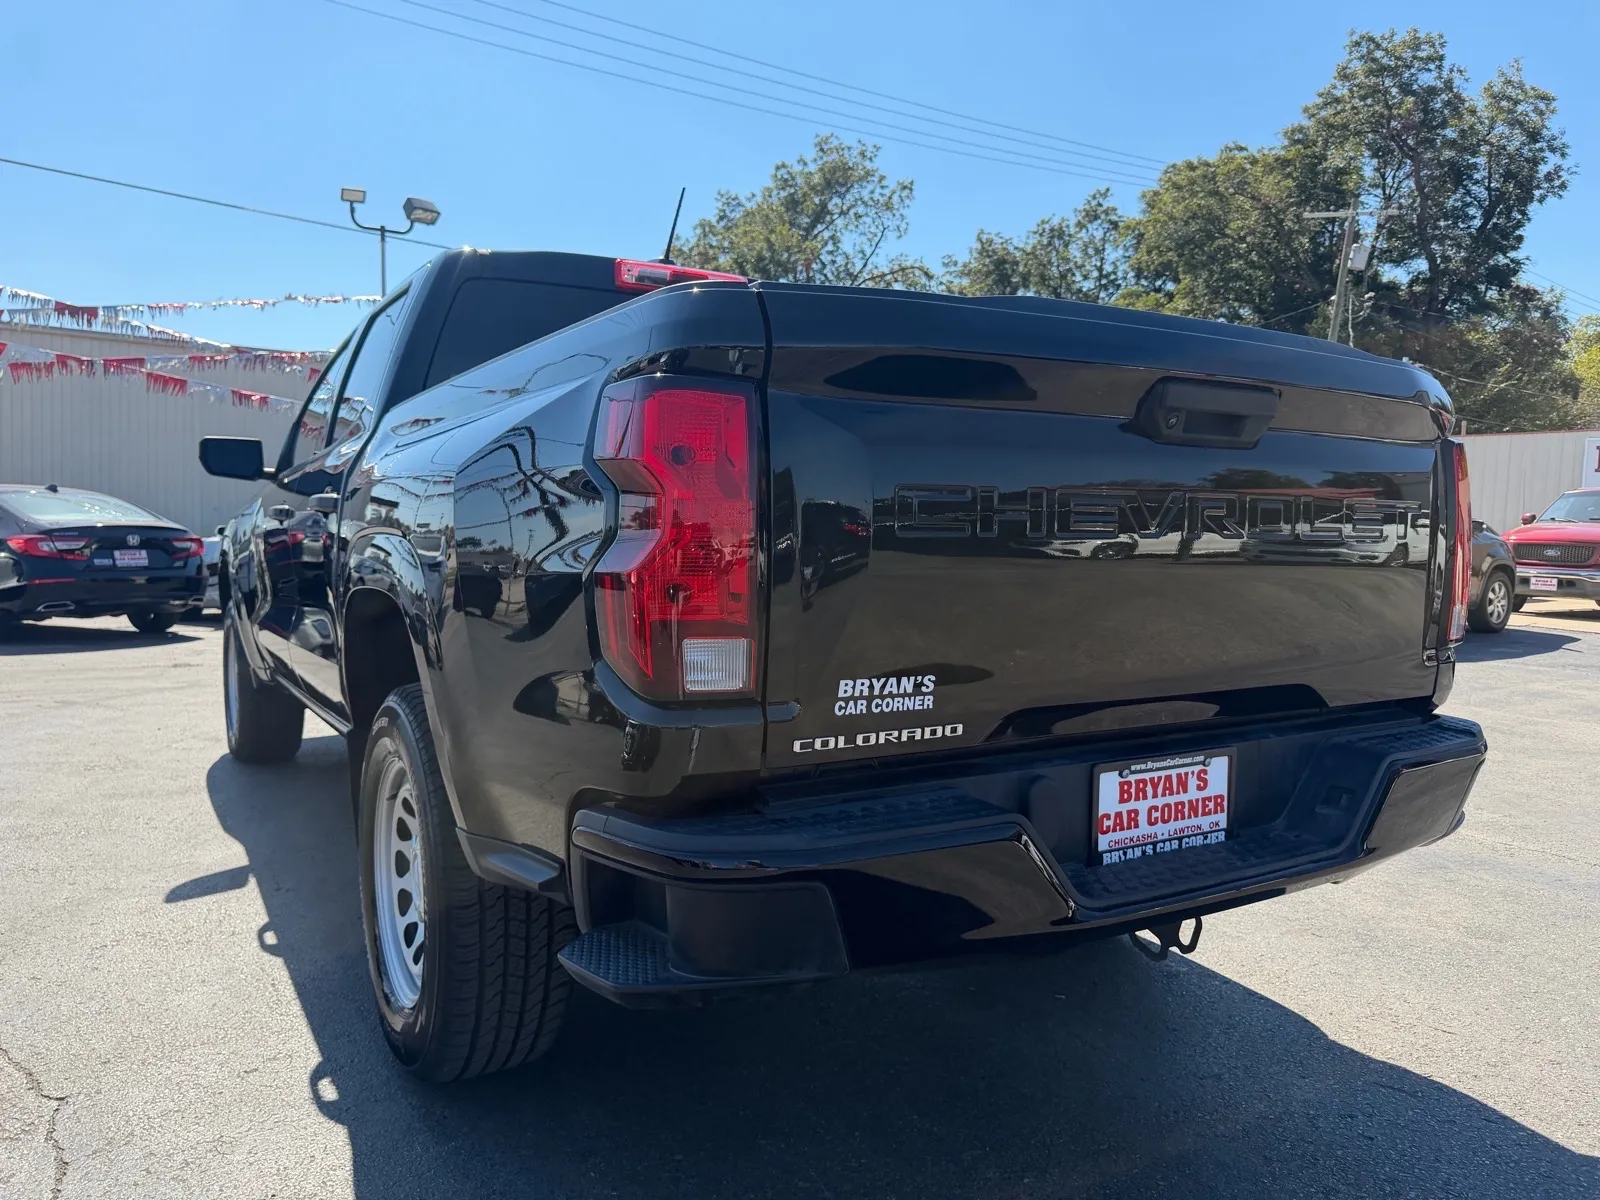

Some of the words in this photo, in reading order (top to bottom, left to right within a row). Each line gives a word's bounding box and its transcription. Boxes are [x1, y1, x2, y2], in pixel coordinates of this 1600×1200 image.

[895, 484, 1422, 541] CHEVROLET
[838, 675, 936, 698] BRYAN'S
[834, 700, 867, 716] CAR
[872, 695, 933, 713] CORNER
[793, 723, 964, 753] COLORADO
[1130, 755, 1205, 770] www.BryansCarCorner.com
[1118, 768, 1208, 804] BRYAN'S
[1097, 808, 1139, 835] CAR
[1146, 794, 1225, 826] CORNER
[1108, 832, 1158, 848] CHICKASHA
[1209, 820, 1220, 830] OK
[1156, 839, 1179, 852] CAR
